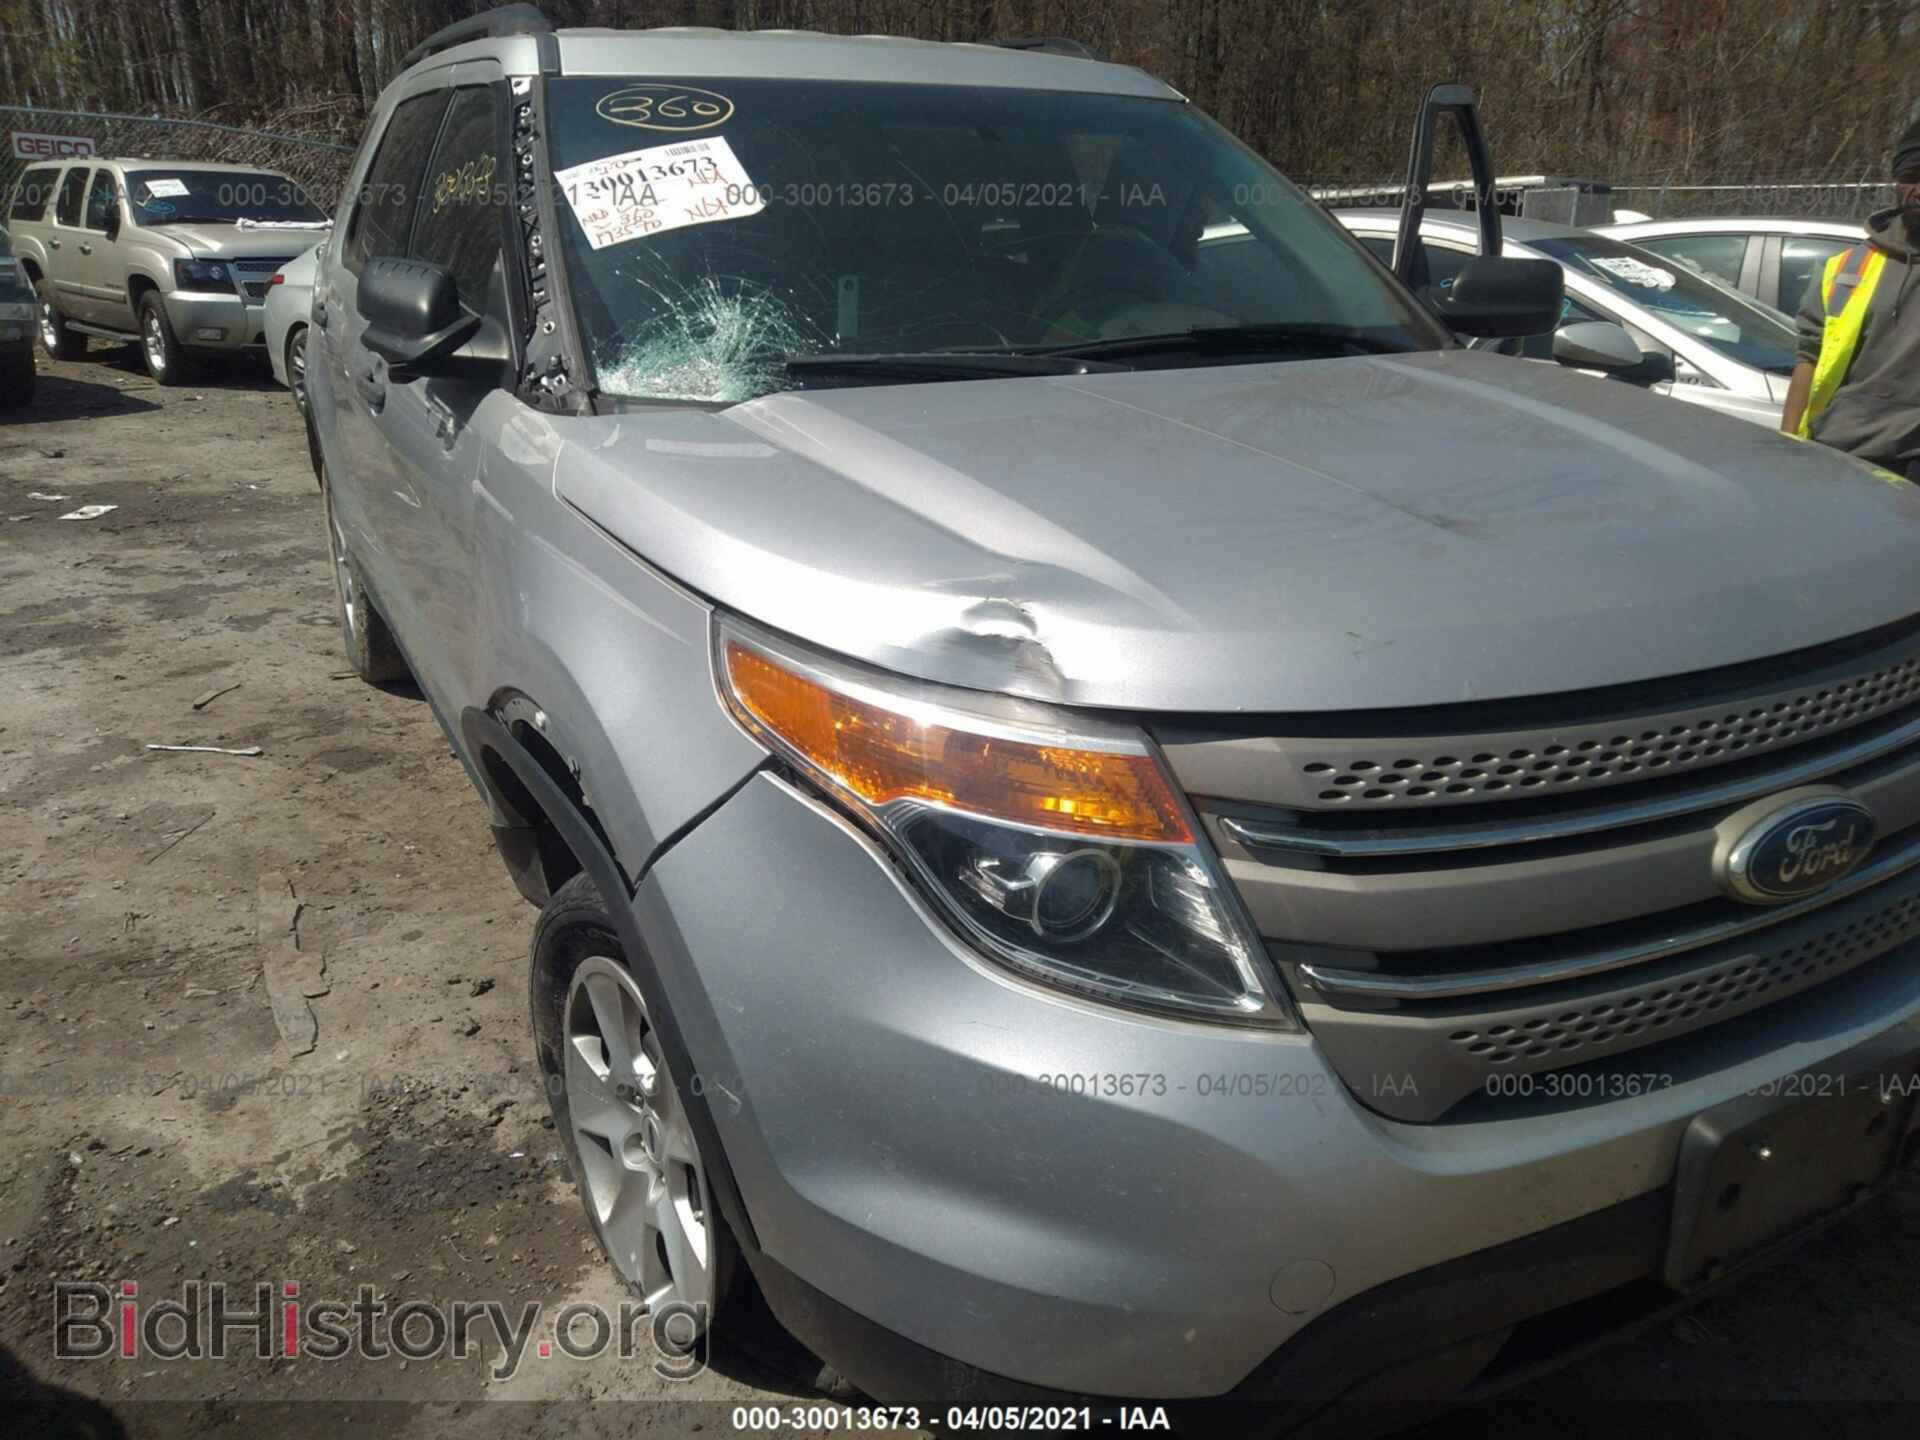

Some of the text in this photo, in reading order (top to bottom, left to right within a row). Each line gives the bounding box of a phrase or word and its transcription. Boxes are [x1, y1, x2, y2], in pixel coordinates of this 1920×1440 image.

[608, 95, 721, 122] 360
[17, 137, 93, 155] GEICO
[1778, 819, 1857, 883] Ford
